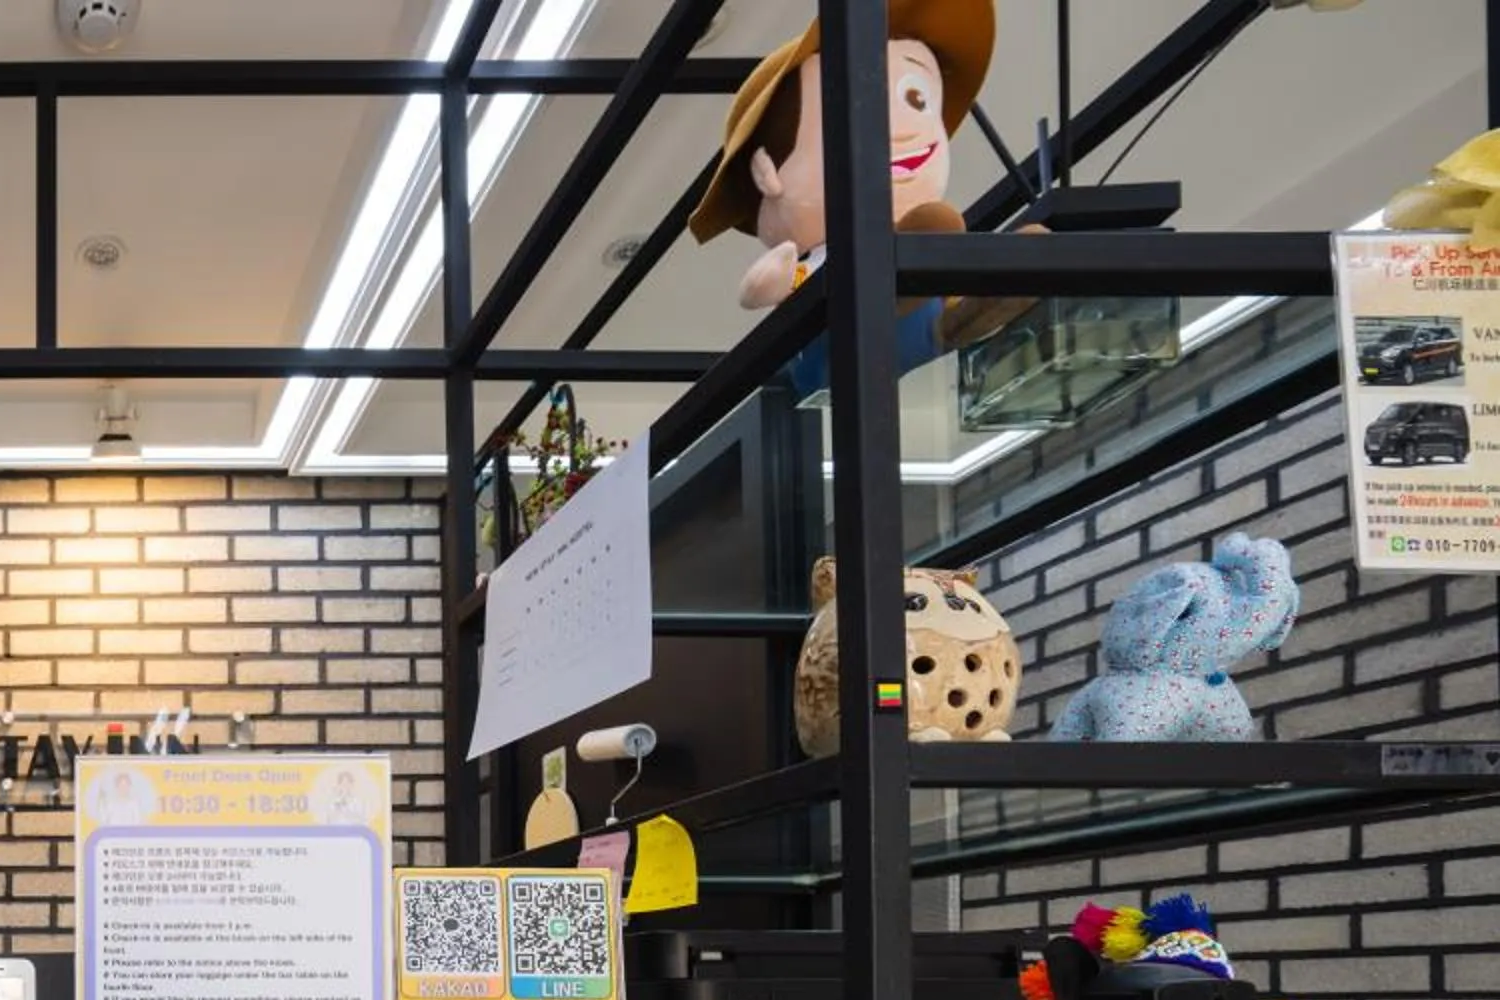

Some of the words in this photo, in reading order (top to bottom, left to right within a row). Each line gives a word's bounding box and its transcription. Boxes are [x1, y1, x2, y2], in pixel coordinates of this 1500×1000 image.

[157, 794, 221, 814] 10:30
[247, 794, 311, 813] 18:30
[418, 979, 489, 997] KAKAO
[540, 980, 585, 998] LINE
